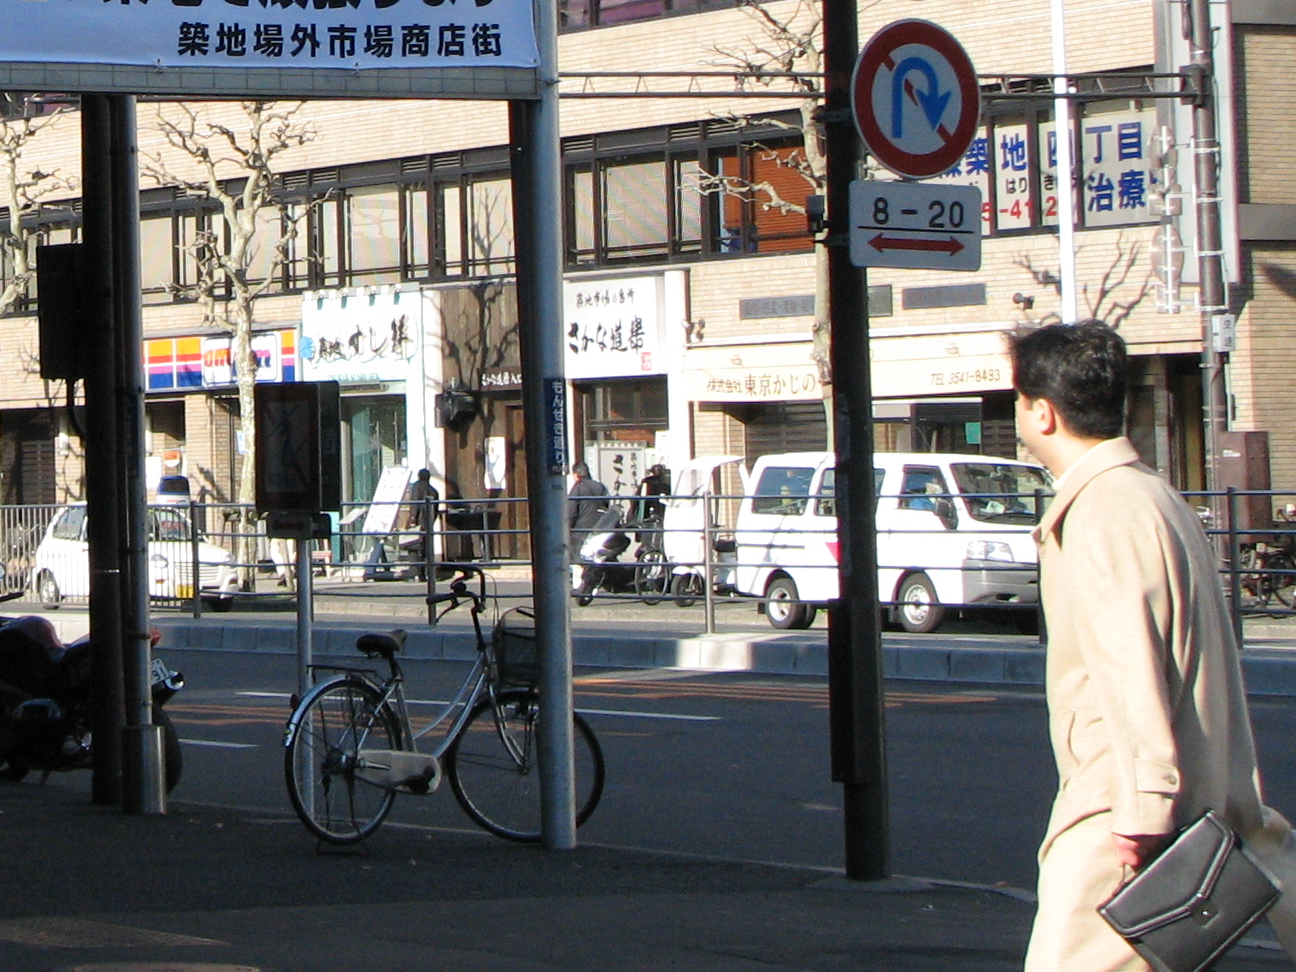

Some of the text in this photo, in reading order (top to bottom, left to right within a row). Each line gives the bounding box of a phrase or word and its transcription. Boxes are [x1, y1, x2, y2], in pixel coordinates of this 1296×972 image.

[178, 21, 503, 58] 築地場外市場商店街
